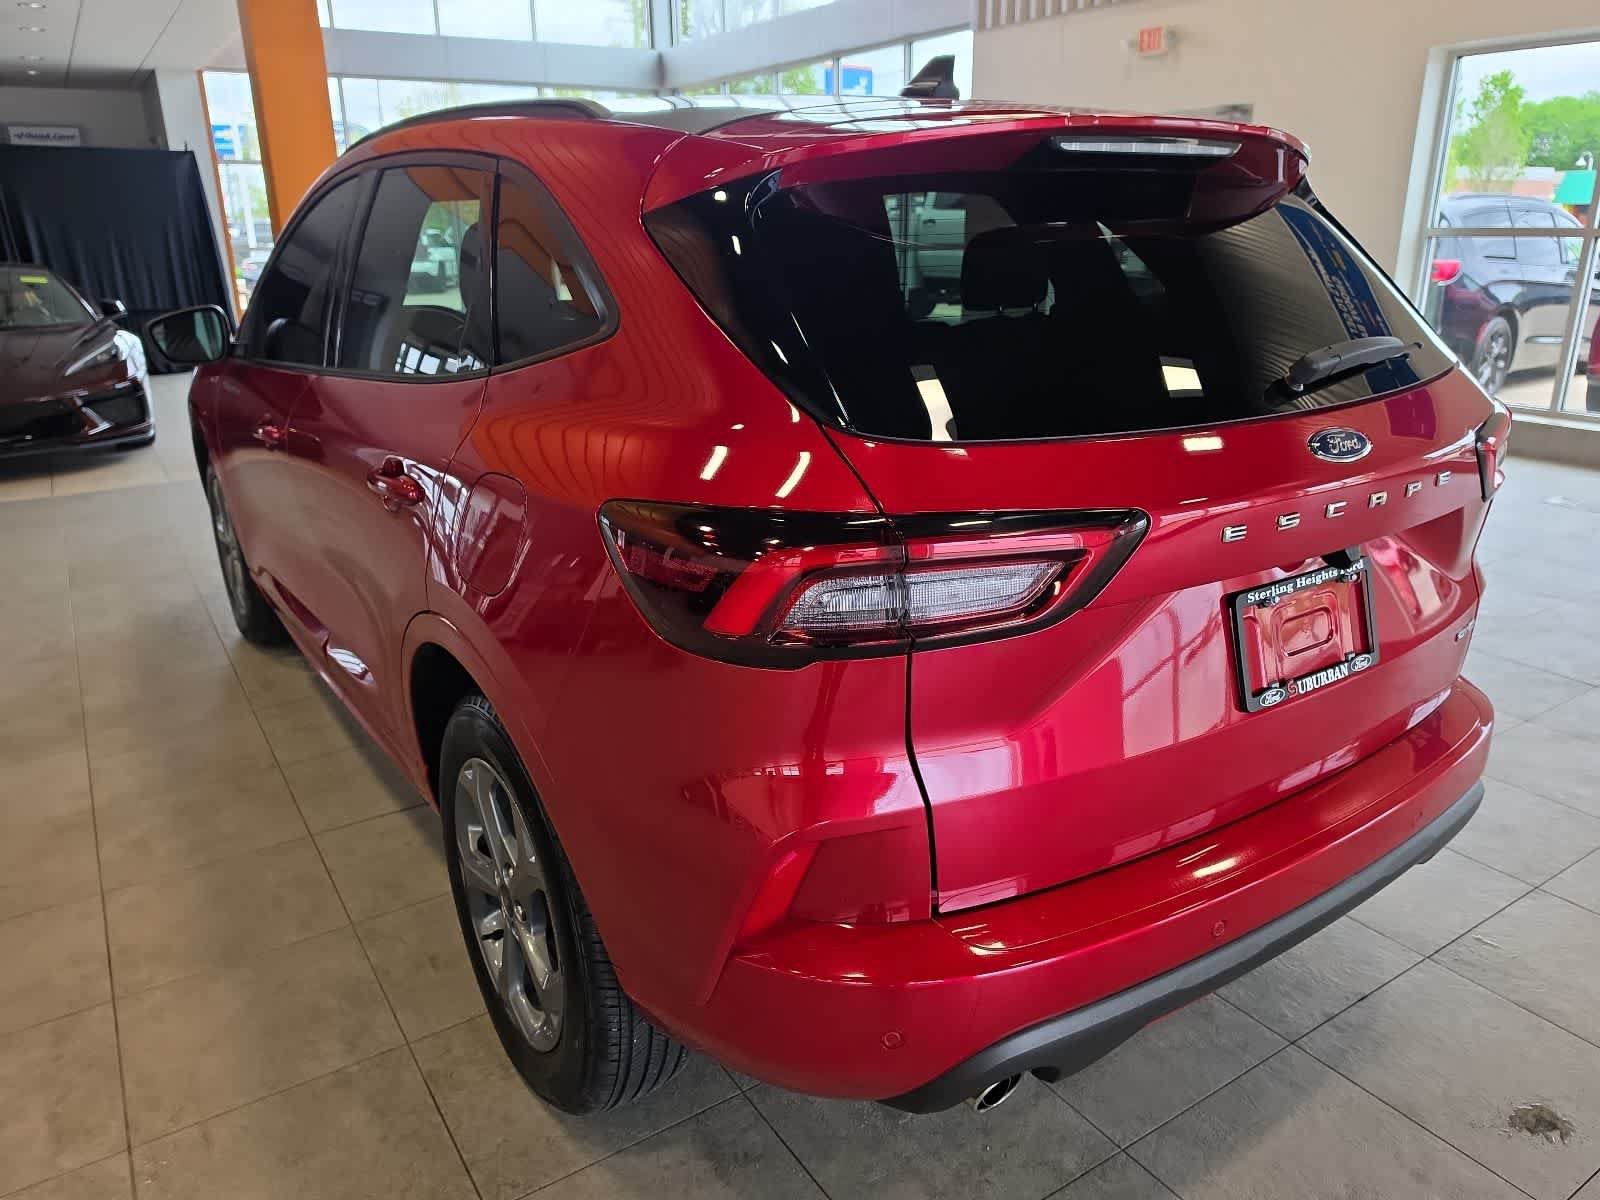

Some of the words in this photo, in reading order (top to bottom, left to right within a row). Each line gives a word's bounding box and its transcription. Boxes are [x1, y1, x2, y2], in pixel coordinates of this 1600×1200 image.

[1327, 432, 1362, 454] Ford
[1222, 470, 1451, 543] ESCAPE
[1246, 582, 1294, 604] Sterling
[1295, 568, 1338, 588] Heights
[1287, 662, 1349, 698] SUBURBAN
